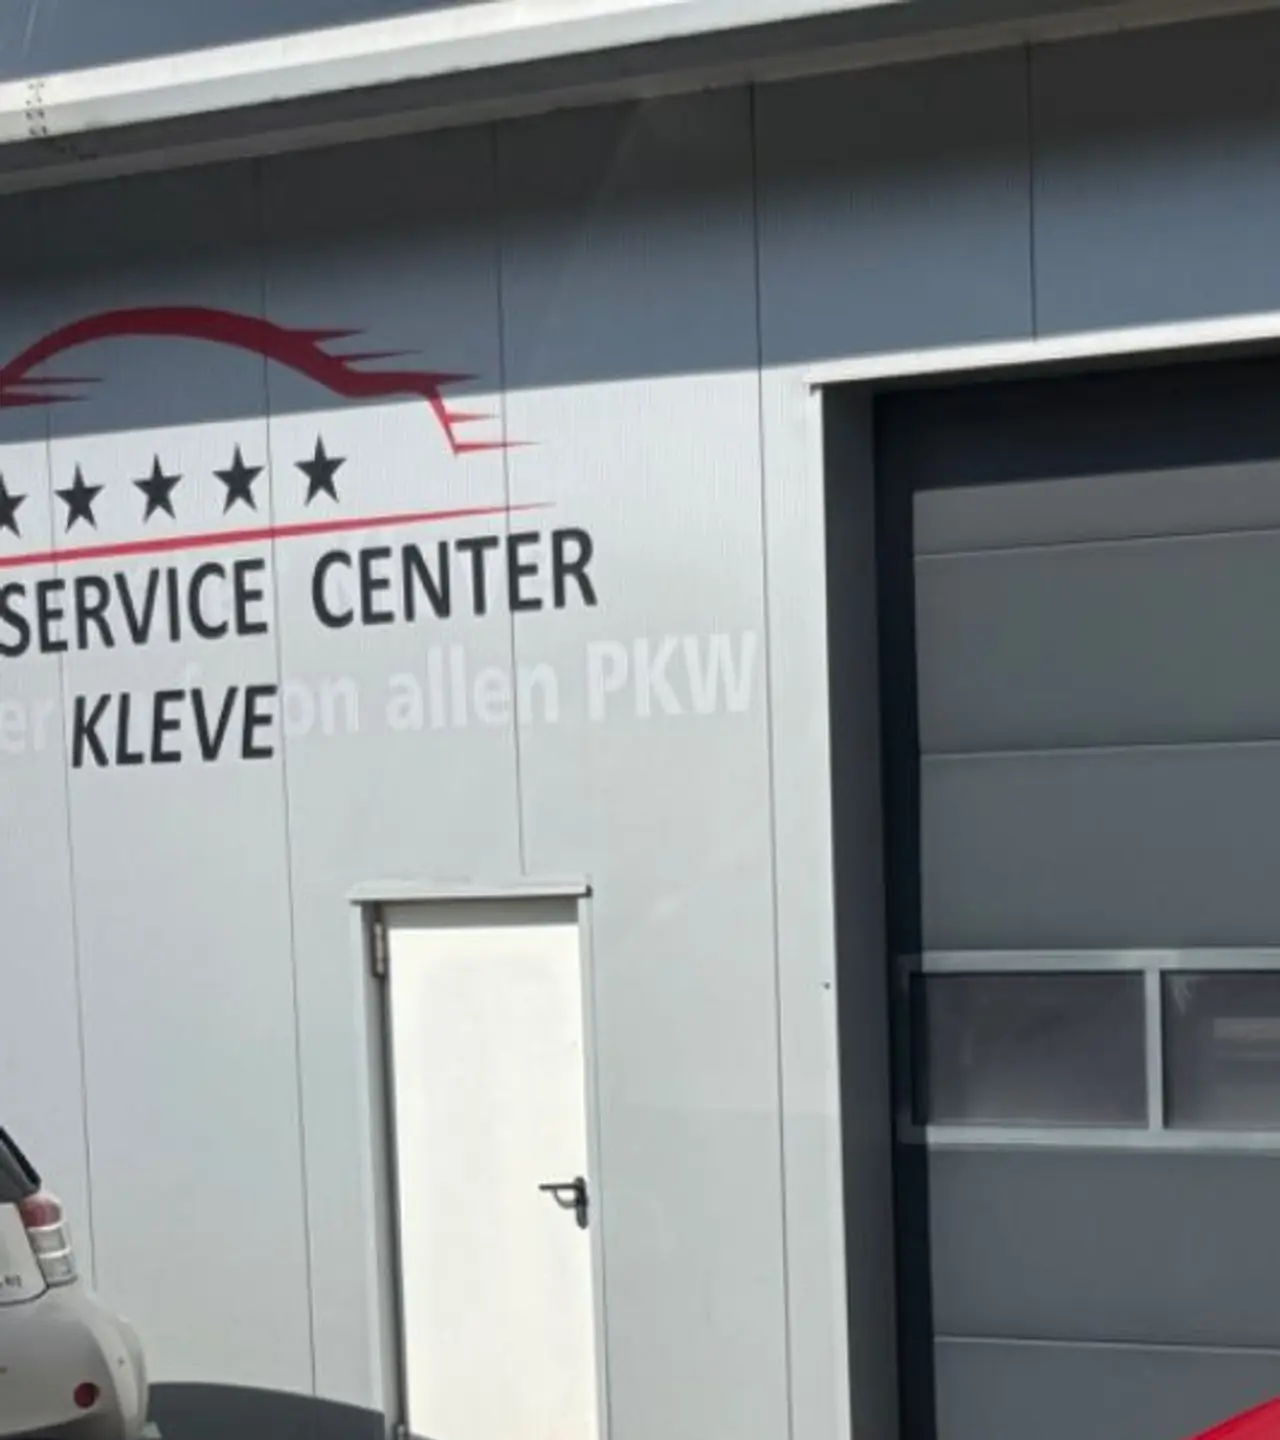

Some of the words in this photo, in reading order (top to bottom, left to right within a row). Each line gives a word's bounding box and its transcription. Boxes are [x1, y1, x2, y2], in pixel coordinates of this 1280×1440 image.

[0, 557, 269, 658] SERVICE
[311, 527, 598, 628] CENTER
[71, 684, 278, 769] KLEVE
[386, 644, 559, 732] allen
[586, 630, 758, 724] PKW
